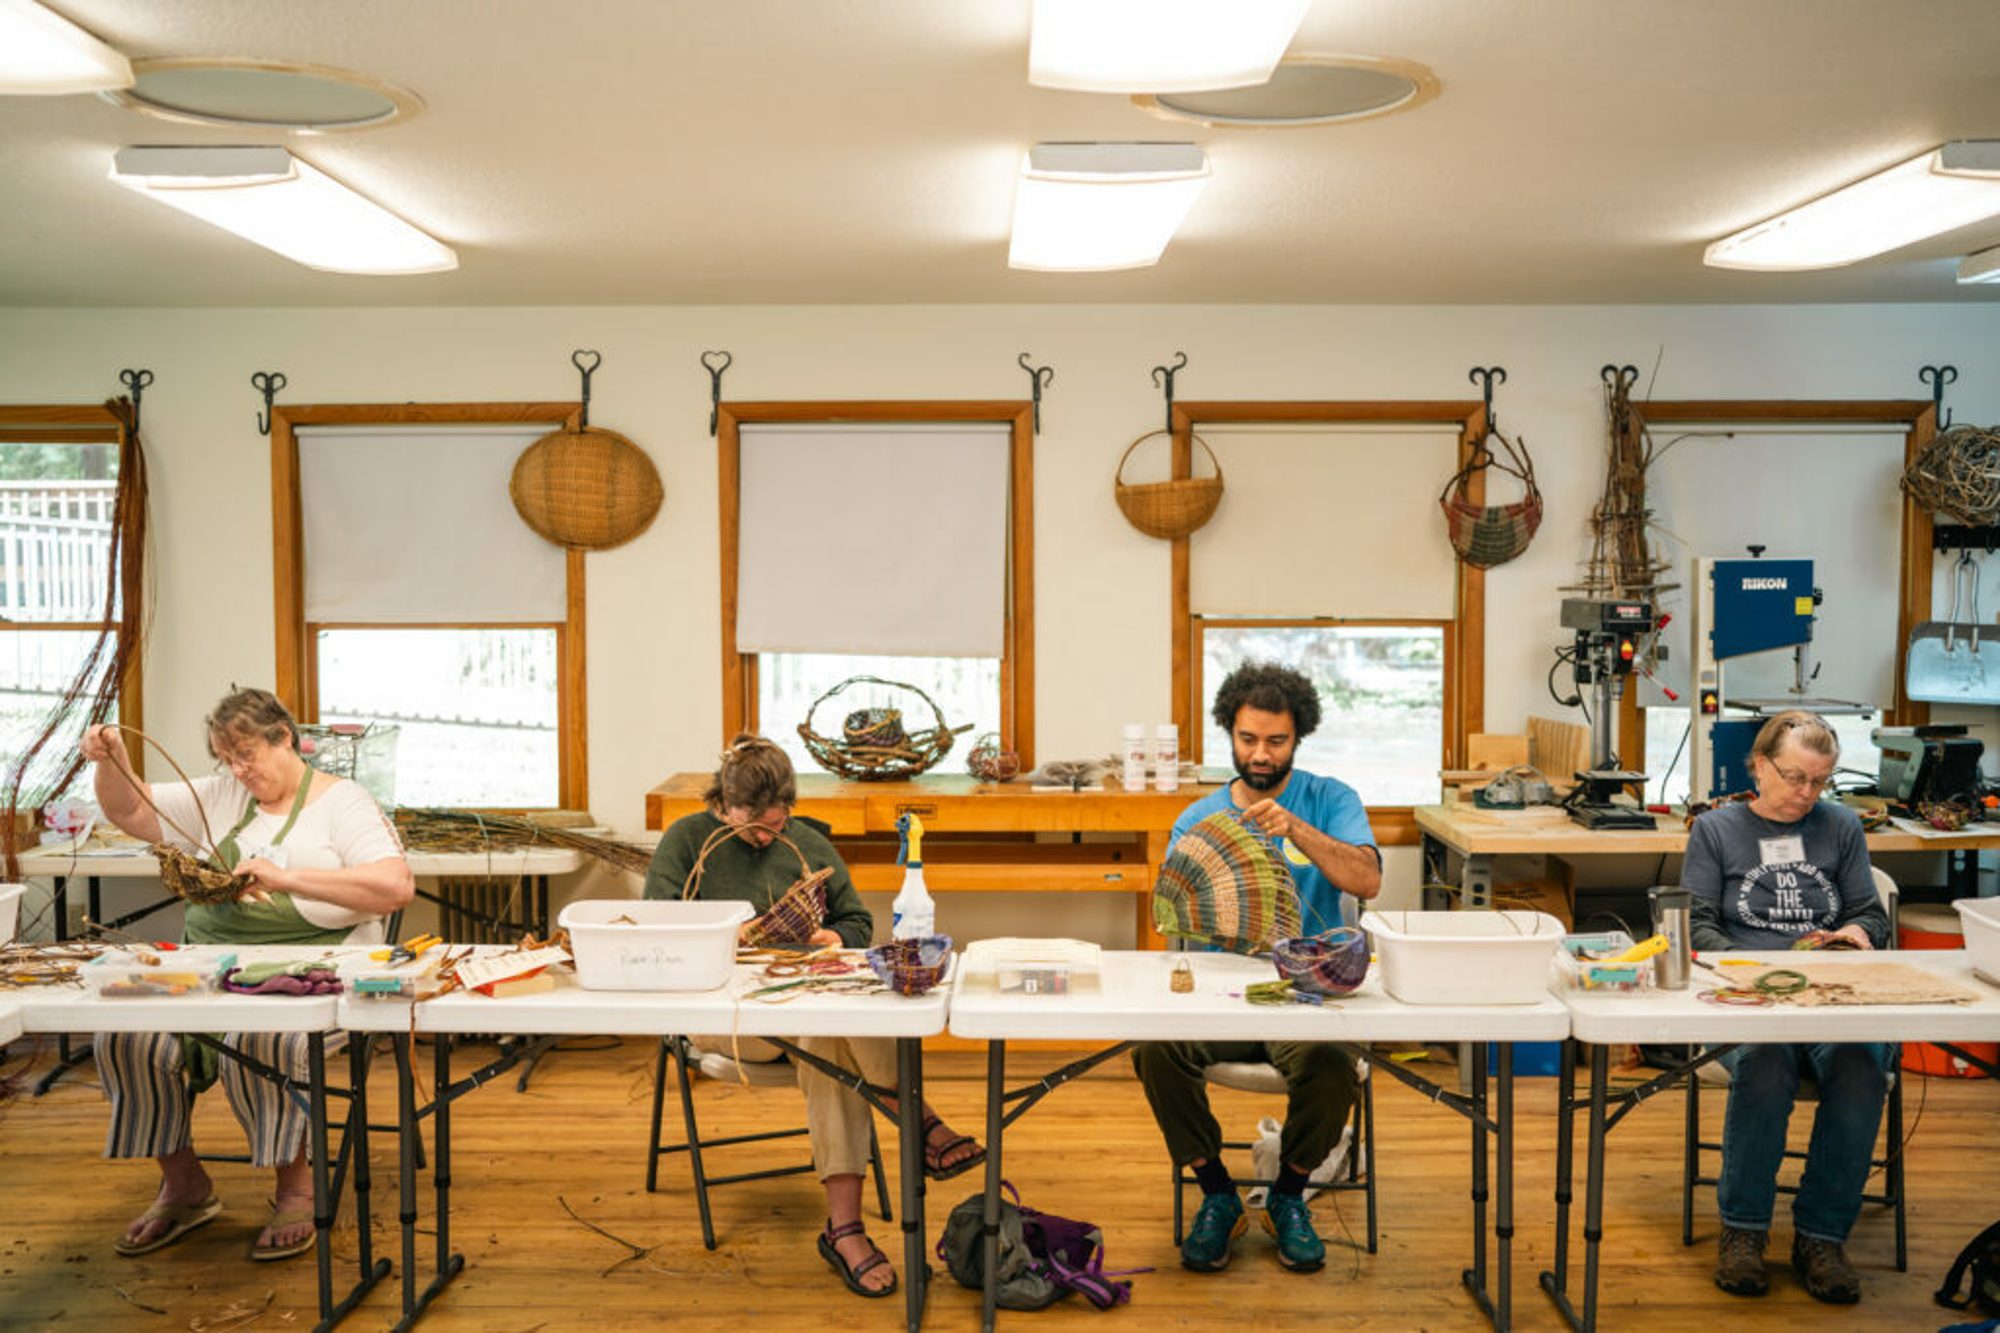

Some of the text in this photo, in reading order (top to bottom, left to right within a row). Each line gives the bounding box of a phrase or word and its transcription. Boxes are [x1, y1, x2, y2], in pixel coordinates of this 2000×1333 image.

[1741, 577, 1788, 590] RIKON
[1775, 872, 1798, 888] DO
[1774, 889, 1804, 909] THE
